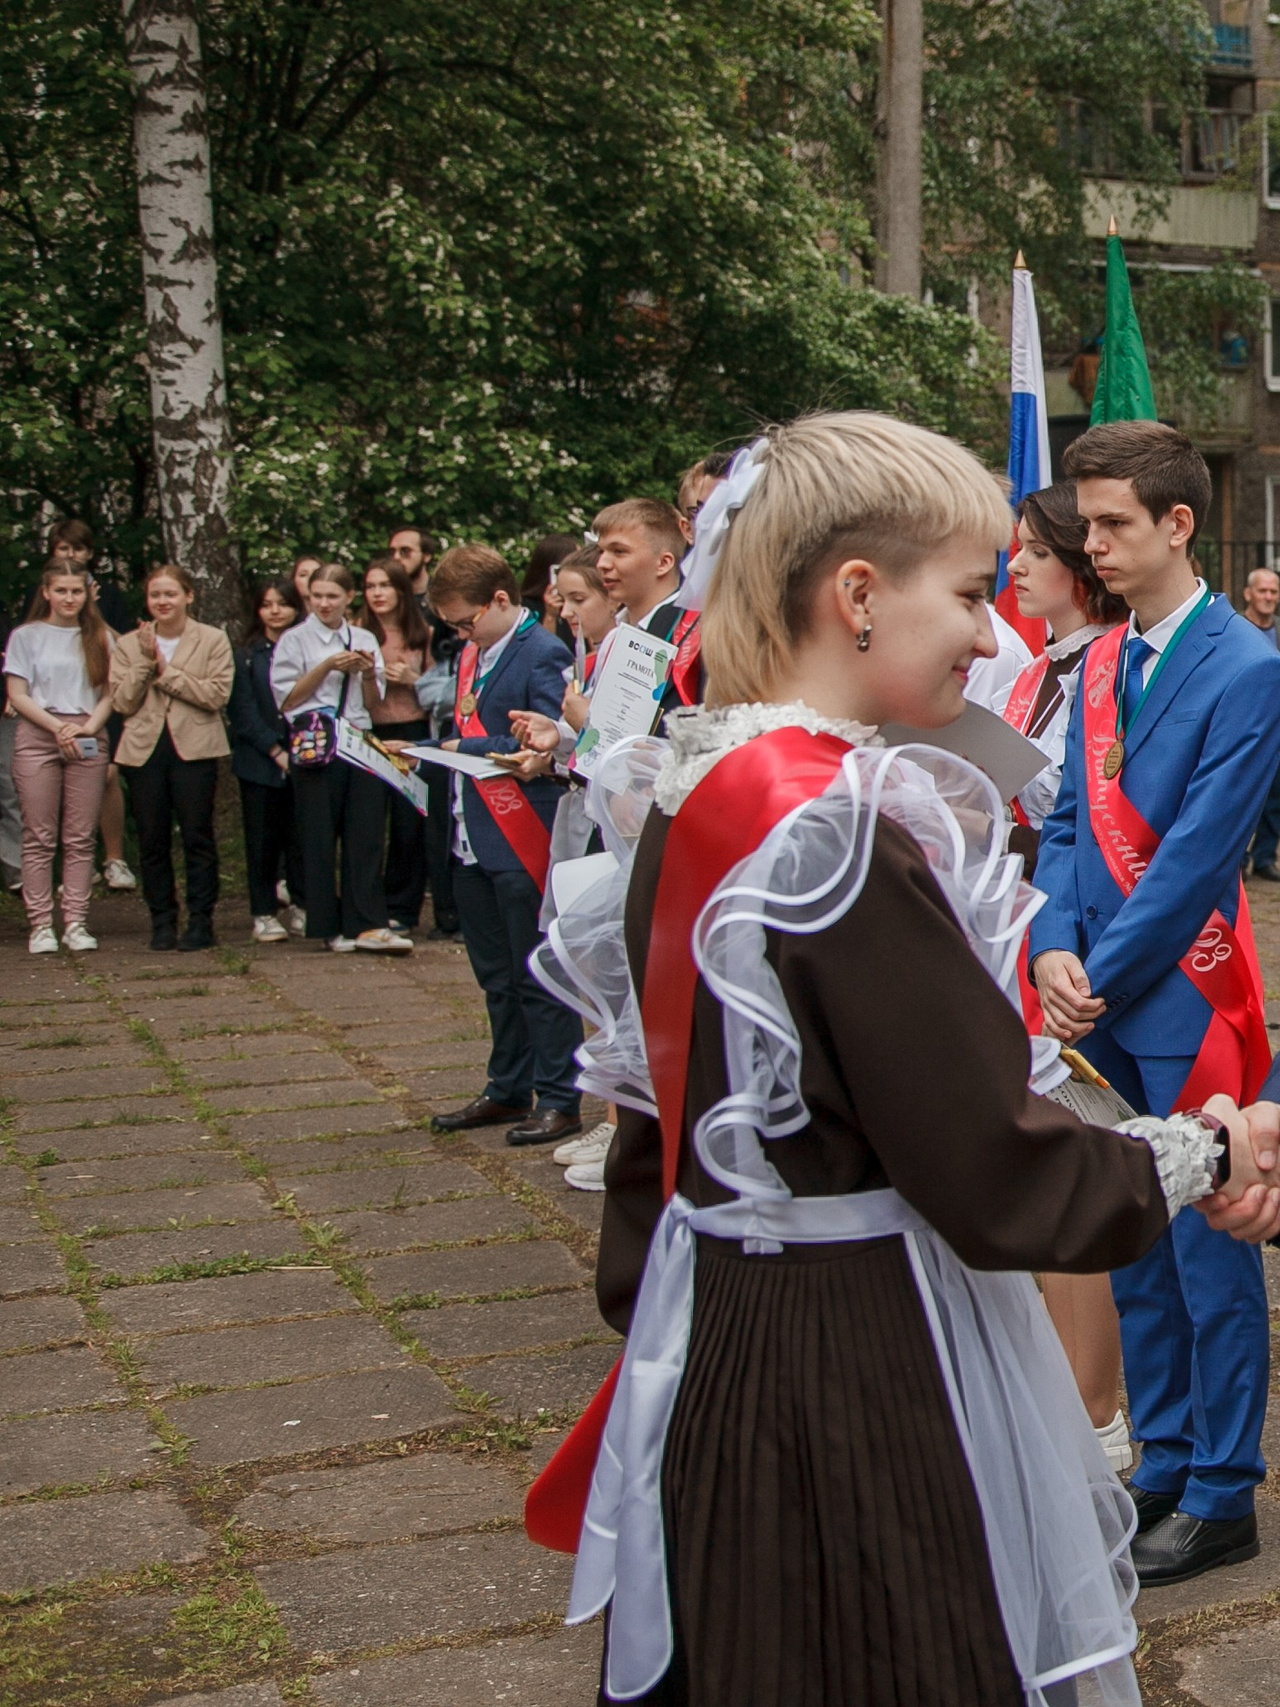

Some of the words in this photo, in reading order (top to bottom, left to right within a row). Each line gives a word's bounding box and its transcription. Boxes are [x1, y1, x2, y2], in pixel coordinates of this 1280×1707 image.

[626, 659, 654, 678] ГРАМОТА
[482, 779, 523, 815] 023
[1090, 716, 1148, 881] Выпускни
